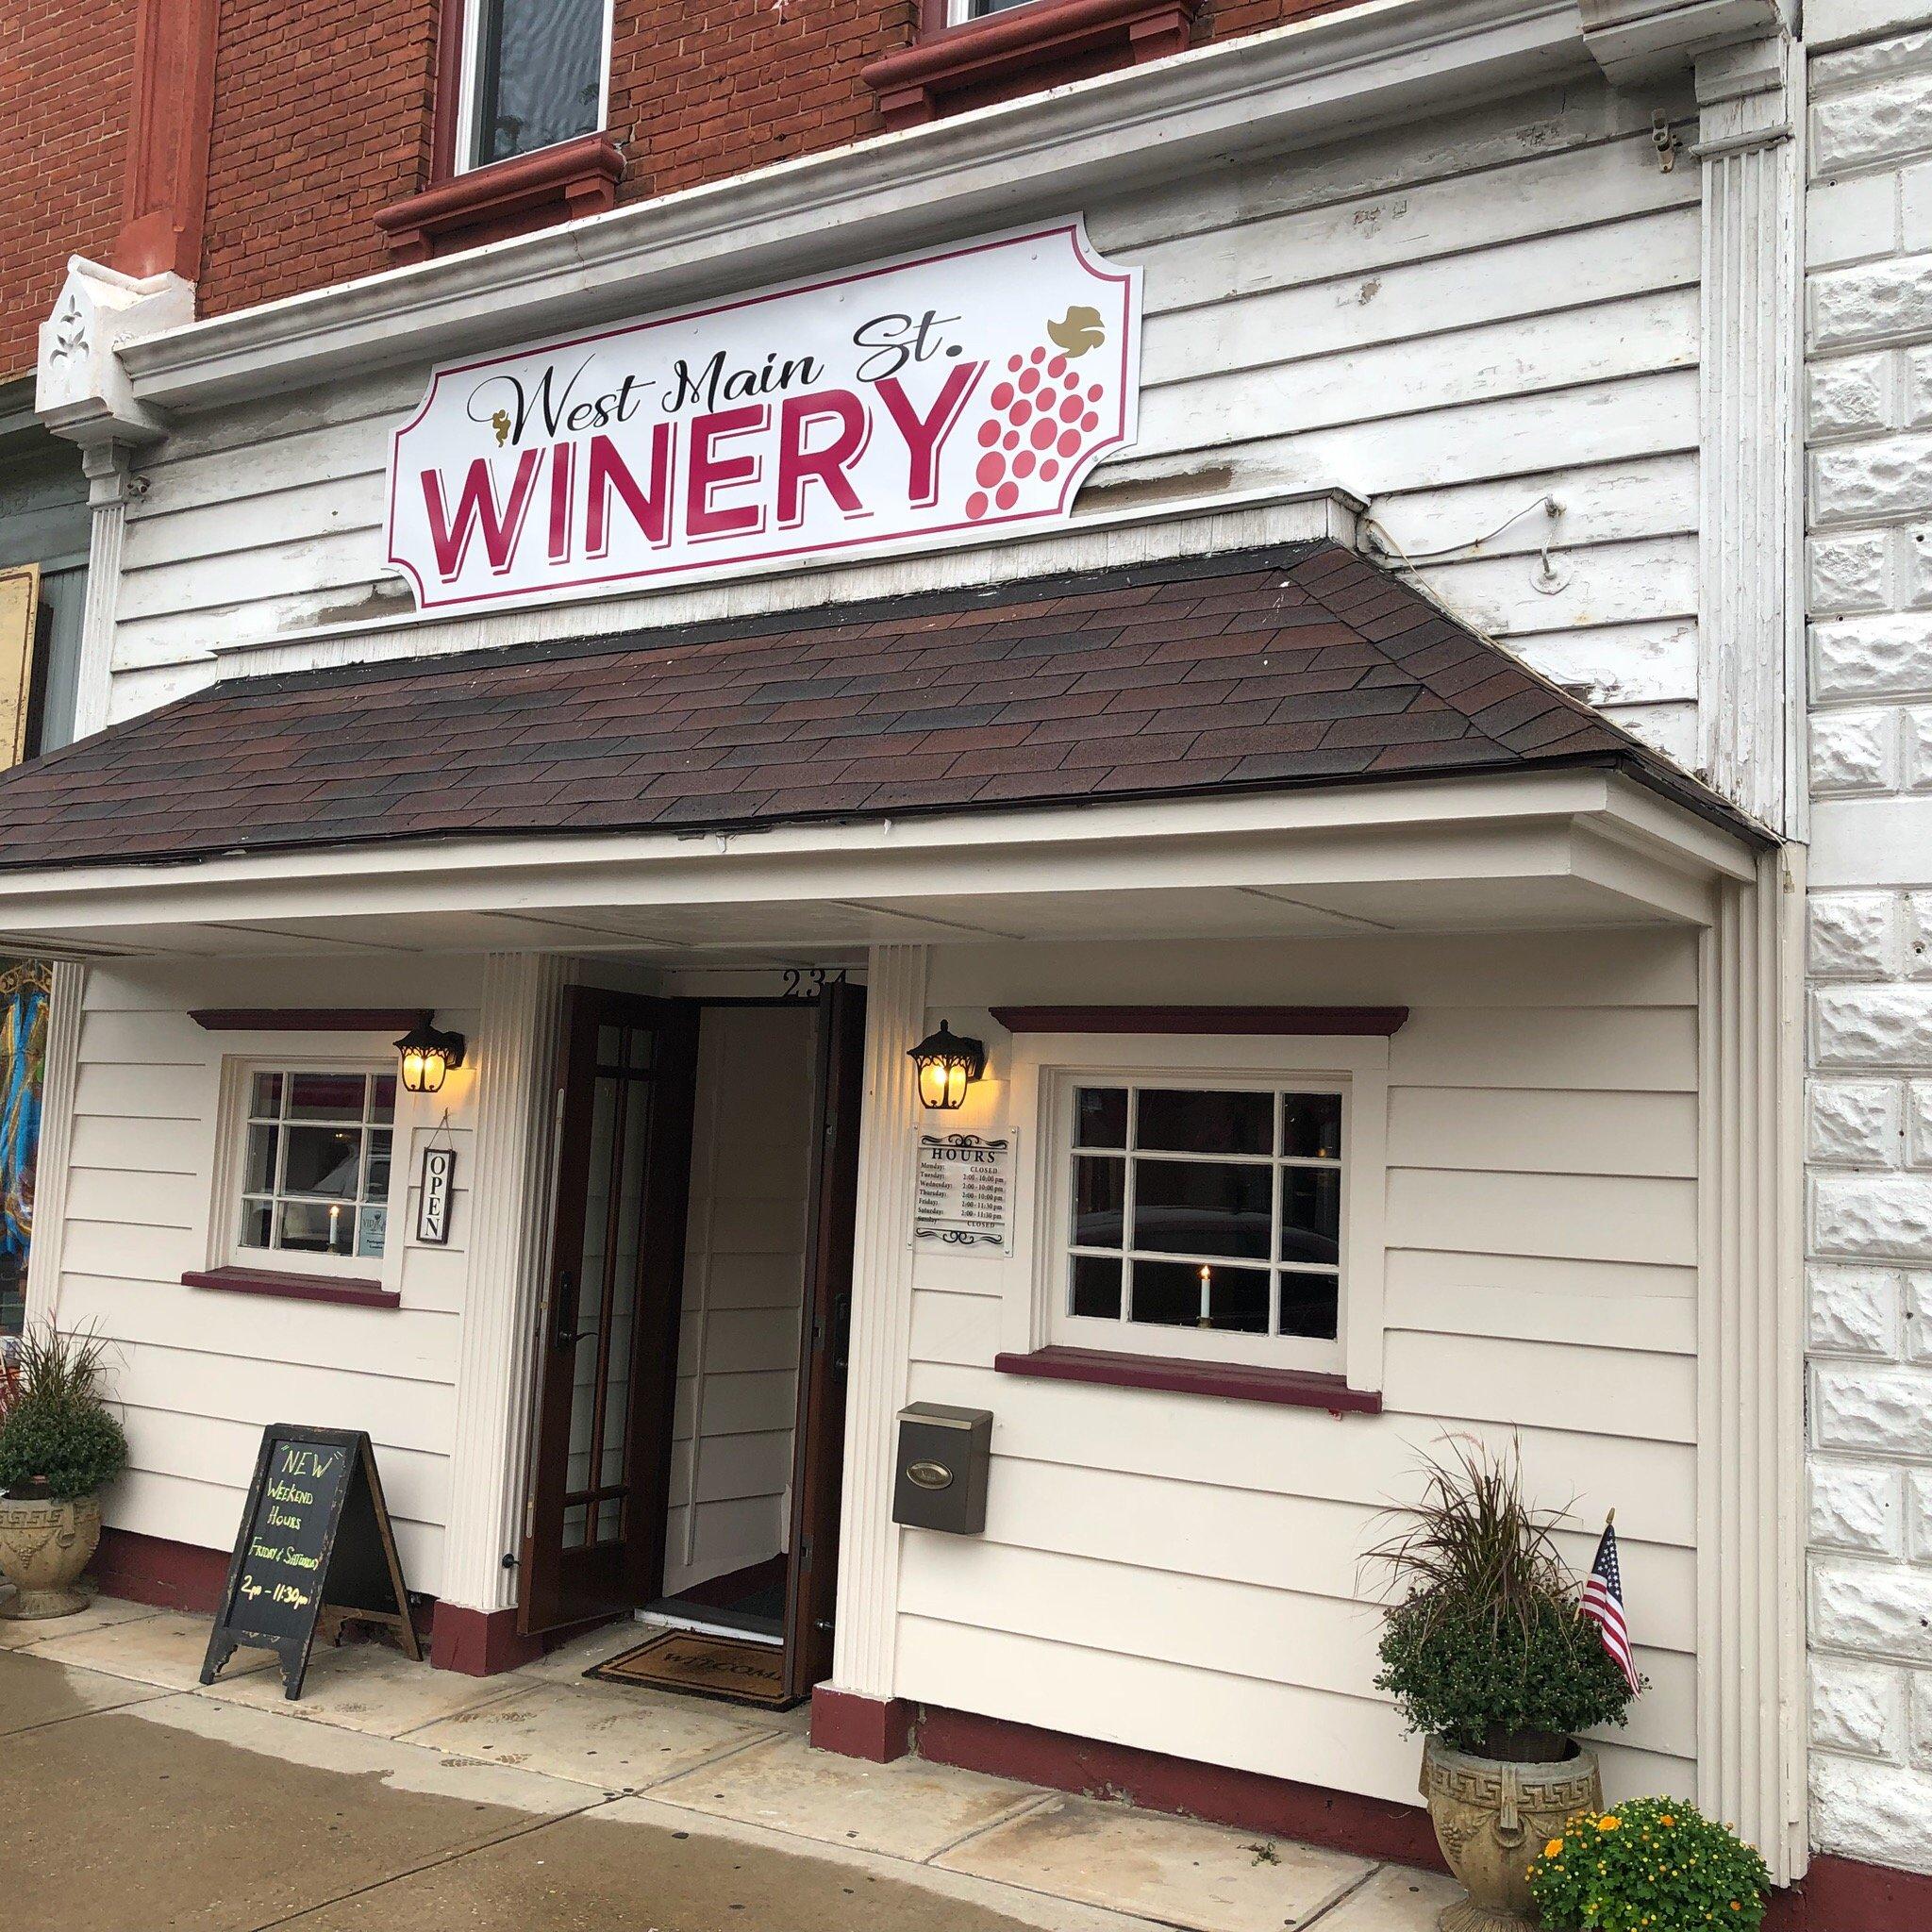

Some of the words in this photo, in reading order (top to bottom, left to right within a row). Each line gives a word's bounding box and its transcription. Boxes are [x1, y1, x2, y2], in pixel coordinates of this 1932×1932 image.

[467, 354, 656, 445] West
[662, 349, 826, 414] Main
[853, 309, 963, 384] St.
[421, 359, 991, 583] WINERY
[932, 1148, 995, 1163] HOURS
[425, 1156, 446, 1237] OPEN
[967, 1220, 995, 1228] CLOSED
